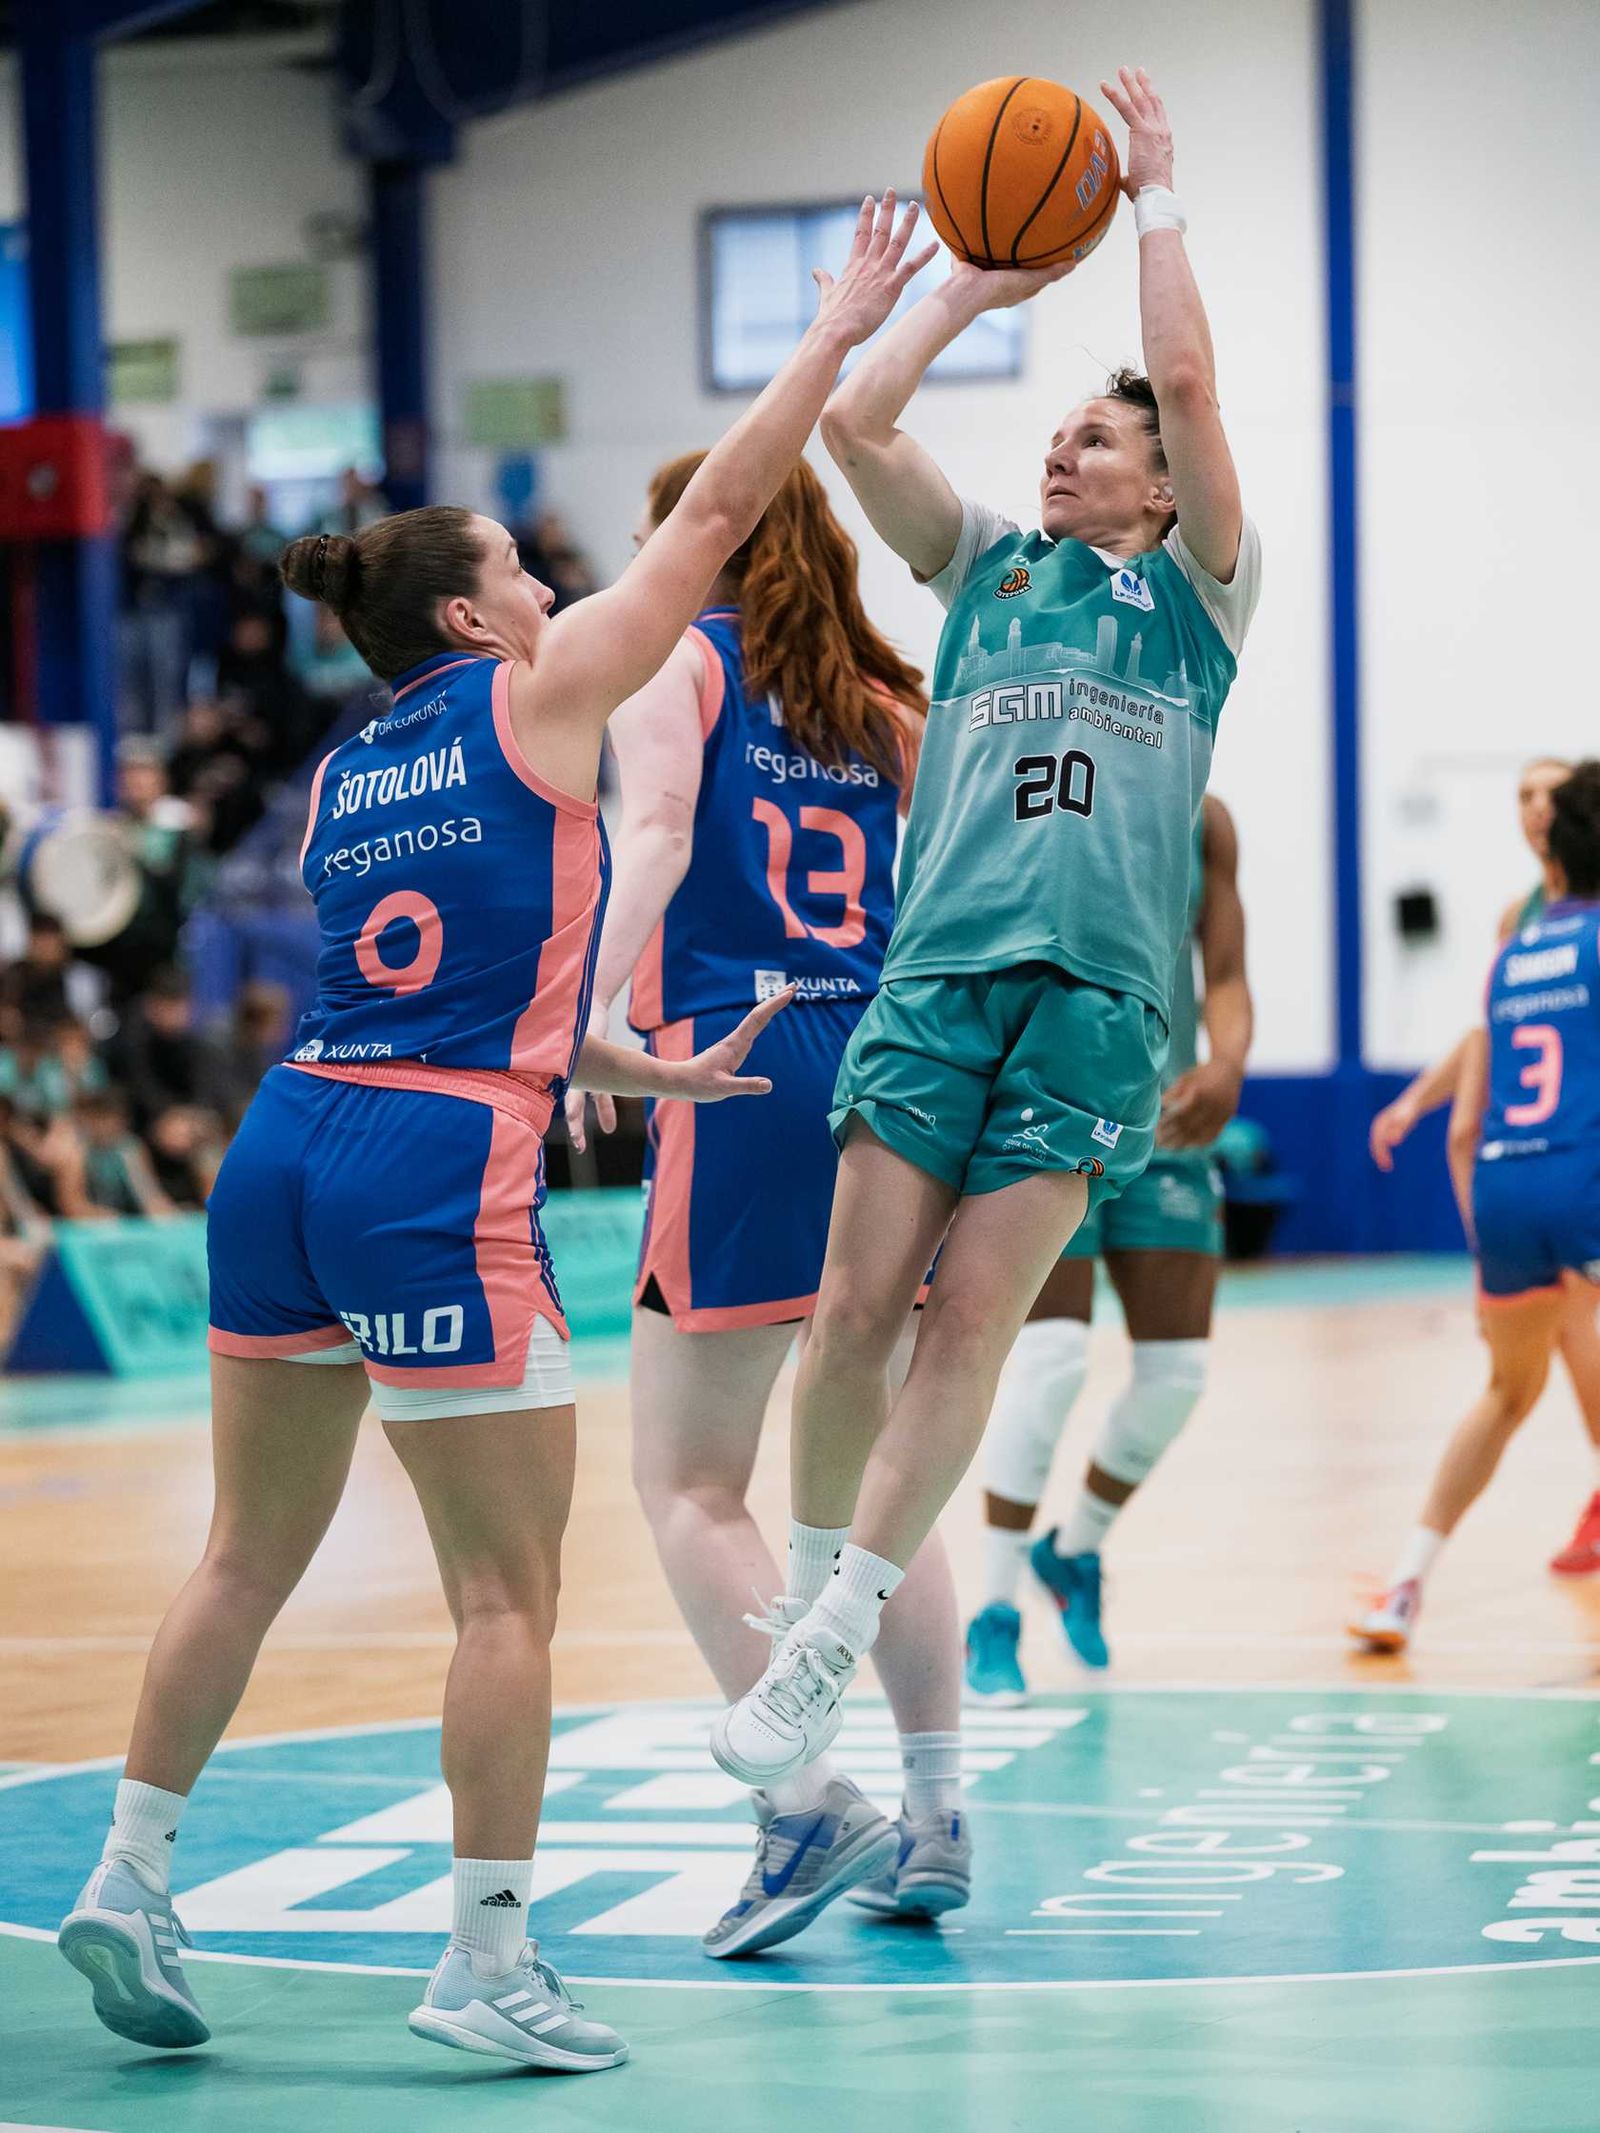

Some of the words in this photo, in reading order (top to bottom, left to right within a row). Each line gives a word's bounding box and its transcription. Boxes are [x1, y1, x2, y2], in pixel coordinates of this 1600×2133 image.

[968, 681, 1064, 734] SGM
[1068, 677, 1165, 725] ingeniería
[1068, 706, 1164, 749] ambiental
[332, 735, 468, 820] ŠOTOLOVÁ
[745, 741, 879, 789] reganosa
[1014, 749, 1097, 823] 20
[323, 816, 483, 877] reganosa
[751, 796, 867, 949] 13
[794, 976, 862, 993] XUNTA
[324, 1043, 393, 1059] XUNTA
[1503, 1023, 1564, 1127] 3
[340, 1304, 464, 1356] RILO
[480, 1896, 522, 1909] adidas
